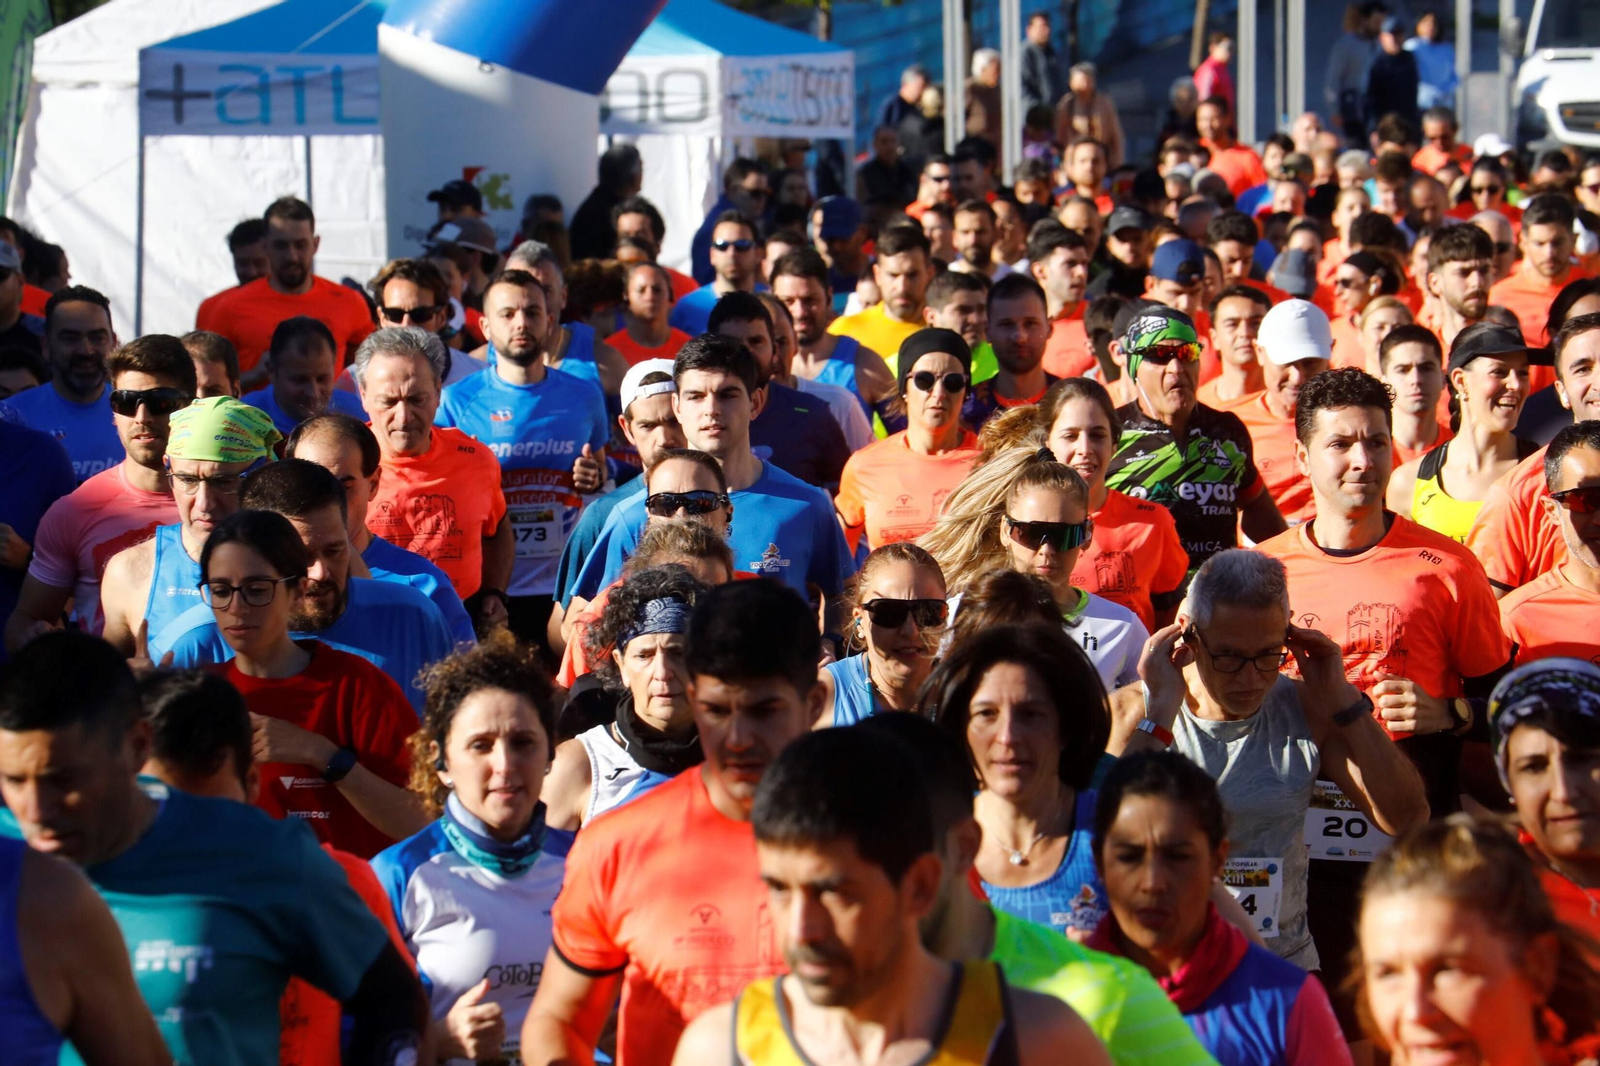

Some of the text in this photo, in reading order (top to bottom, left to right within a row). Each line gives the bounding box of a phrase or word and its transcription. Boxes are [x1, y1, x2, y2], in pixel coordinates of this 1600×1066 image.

[490, 438, 575, 459] enerplus
[1322, 816, 1368, 839] 20
[1241, 894, 1258, 916] 4
